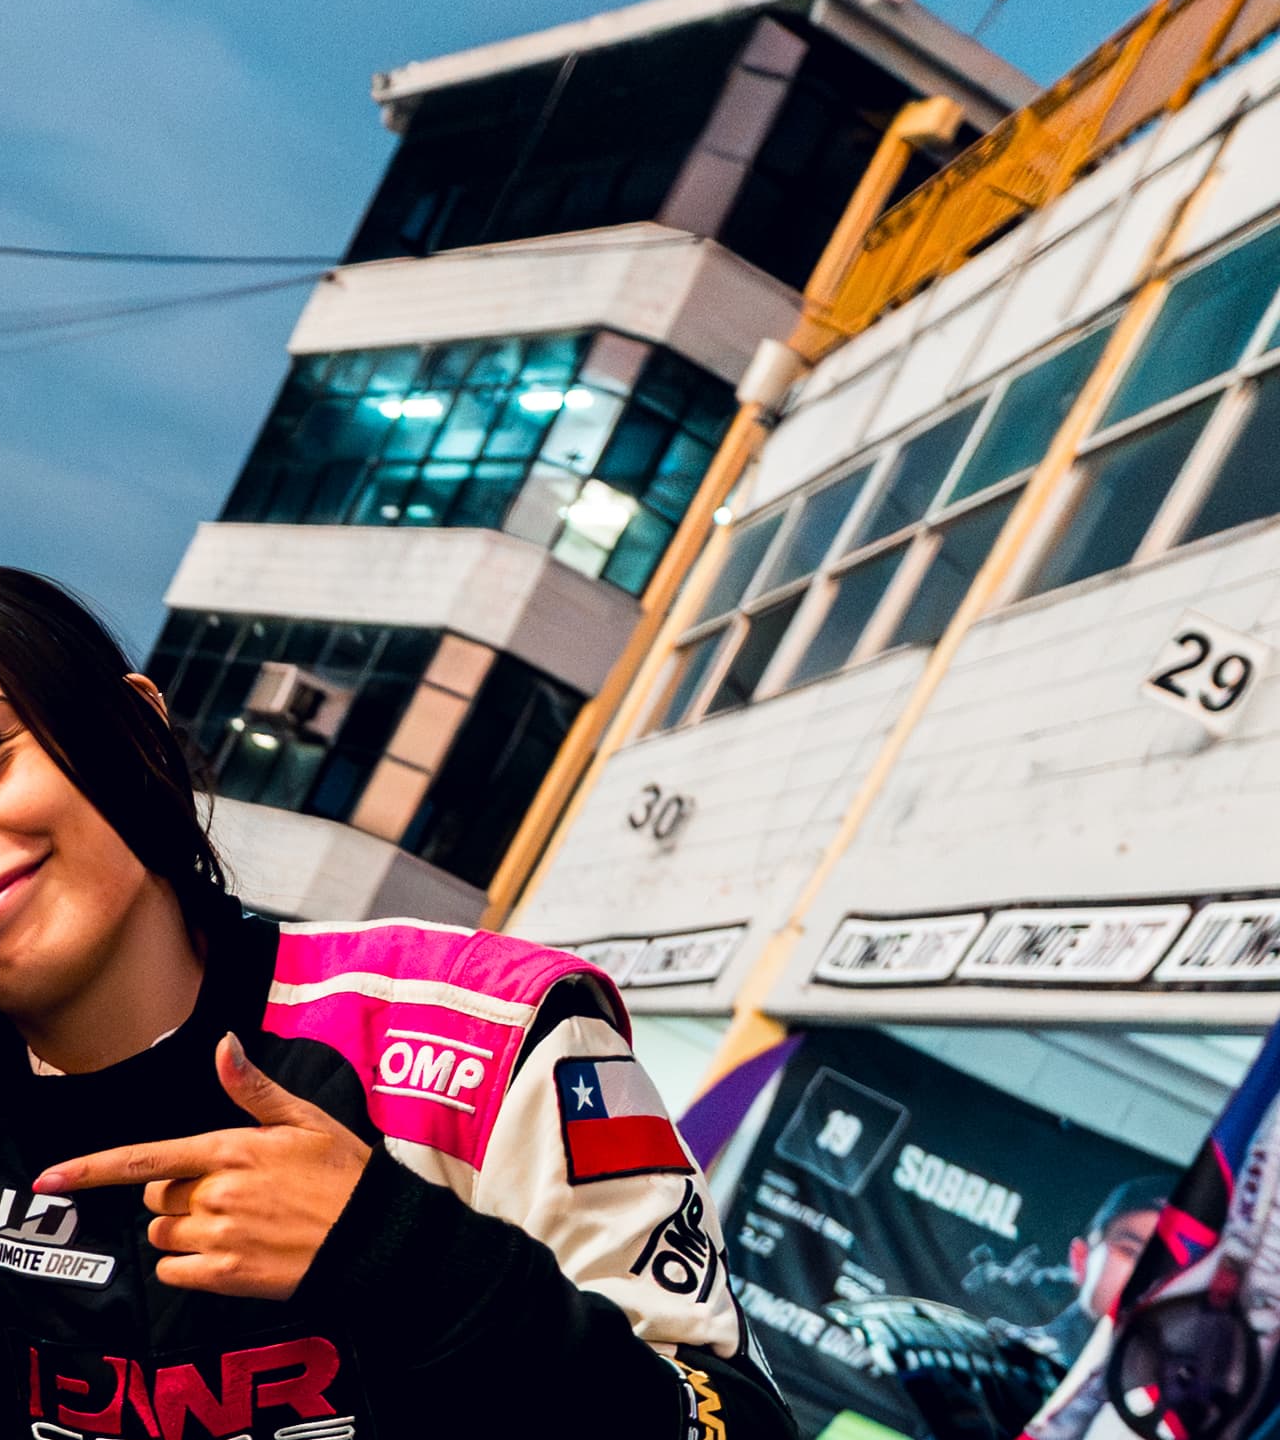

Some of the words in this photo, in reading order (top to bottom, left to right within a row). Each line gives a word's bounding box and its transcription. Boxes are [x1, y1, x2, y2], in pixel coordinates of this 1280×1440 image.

[1150, 630, 1253, 713] 29
[628, 784, 688, 840] 30
[379, 1041, 485, 1098] OMP
[893, 1143, 1022, 1240] SOBRAL
[45, 1250, 107, 1279] DRIFT
